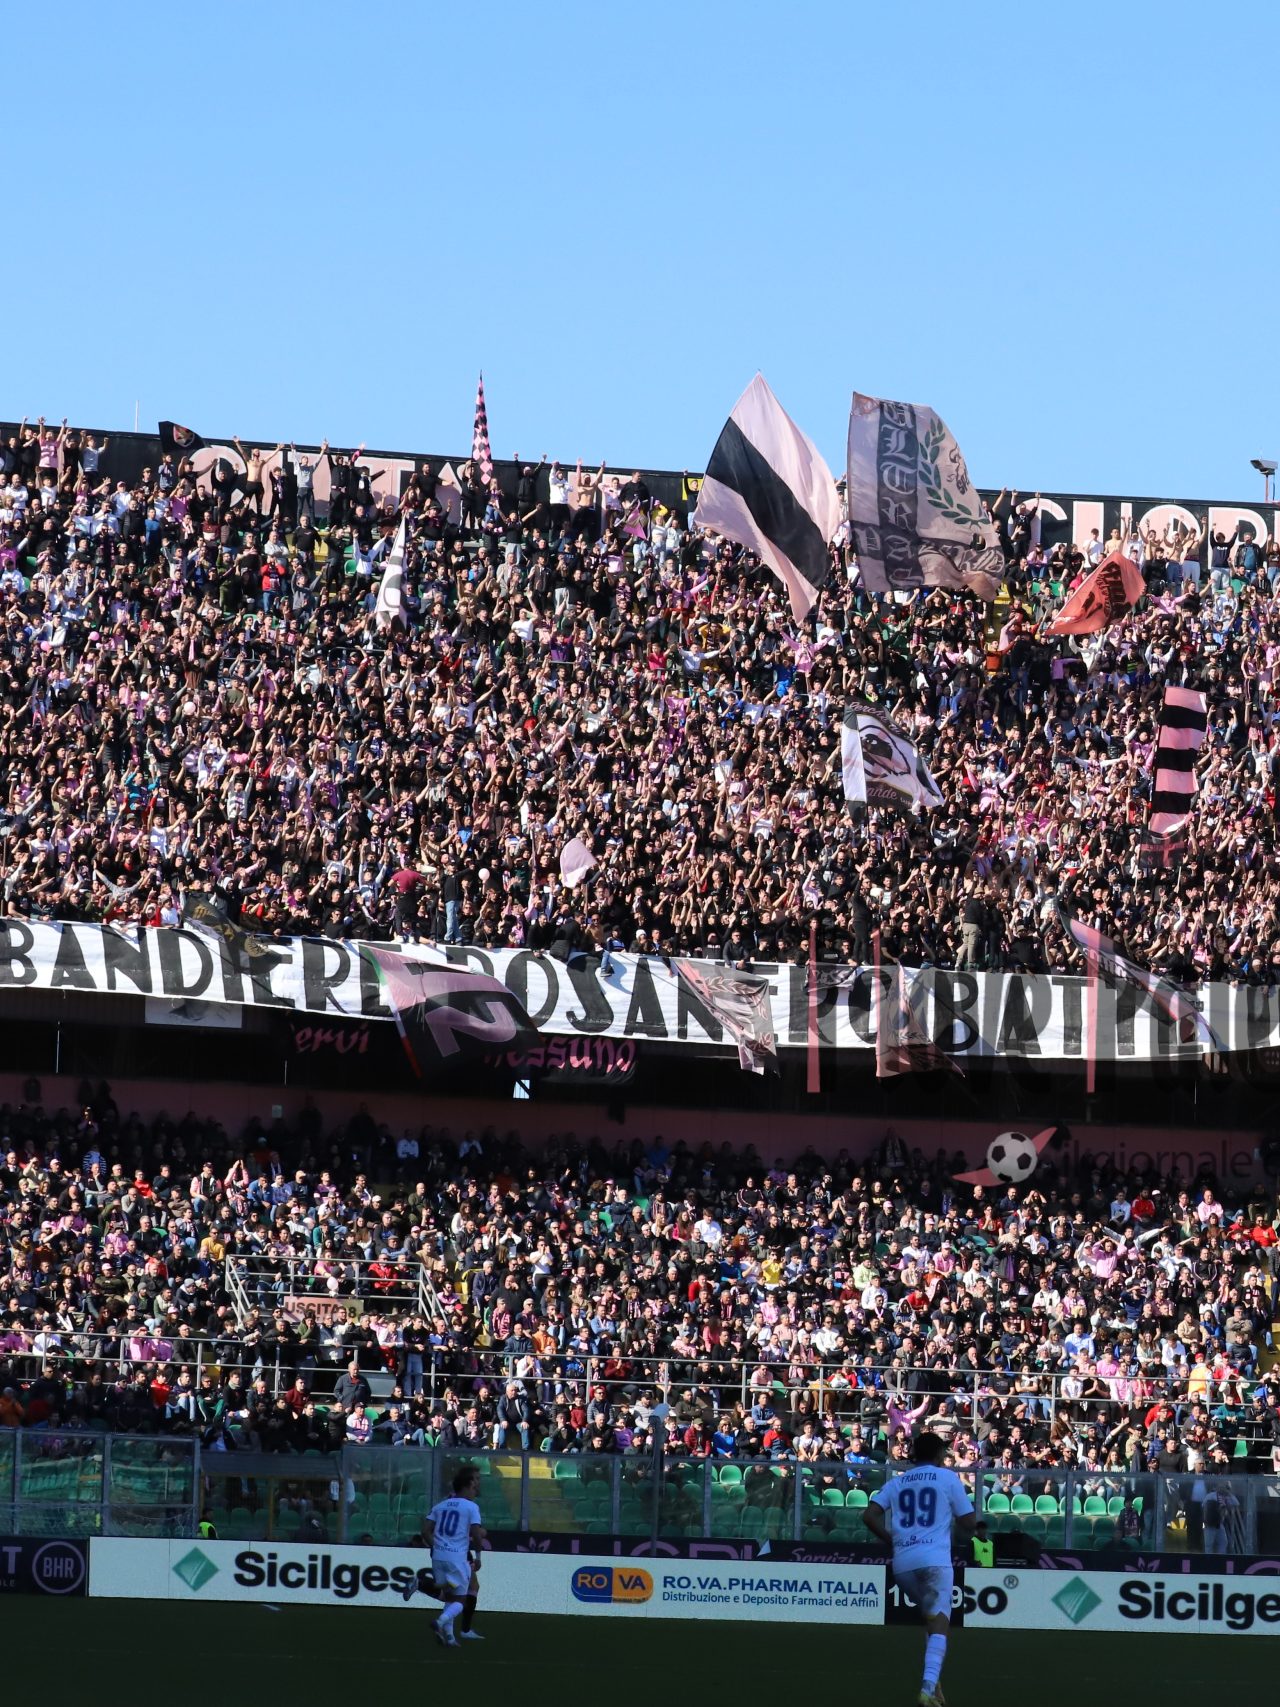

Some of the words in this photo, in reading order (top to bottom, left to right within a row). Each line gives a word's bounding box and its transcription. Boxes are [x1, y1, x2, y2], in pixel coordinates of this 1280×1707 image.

[446, 945, 905, 1050] OSANRO
[287, 1022, 369, 1054] ervi
[484, 1035, 638, 1073] essuno
[347, 1306, 357, 1319] 8
[898, 1486, 938, 1529] 99
[438, 1509, 461, 1537] 10
[43, 1557, 75, 1578] BHR
[233, 1550, 435, 1599] Sicilgess
[662, 1575, 813, 1594] RO.VA.PHARMA
[818, 1580, 879, 1596] ITALIA
[662, 1591, 731, 1604] Distribuzione
[732, 1595, 741, 1604] e
[742, 1593, 789, 1608] Deposito
[790, 1595, 833, 1607] Farmaci
[834, 1595, 848, 1607] ed
[849, 1596, 879, 1608] Affini
